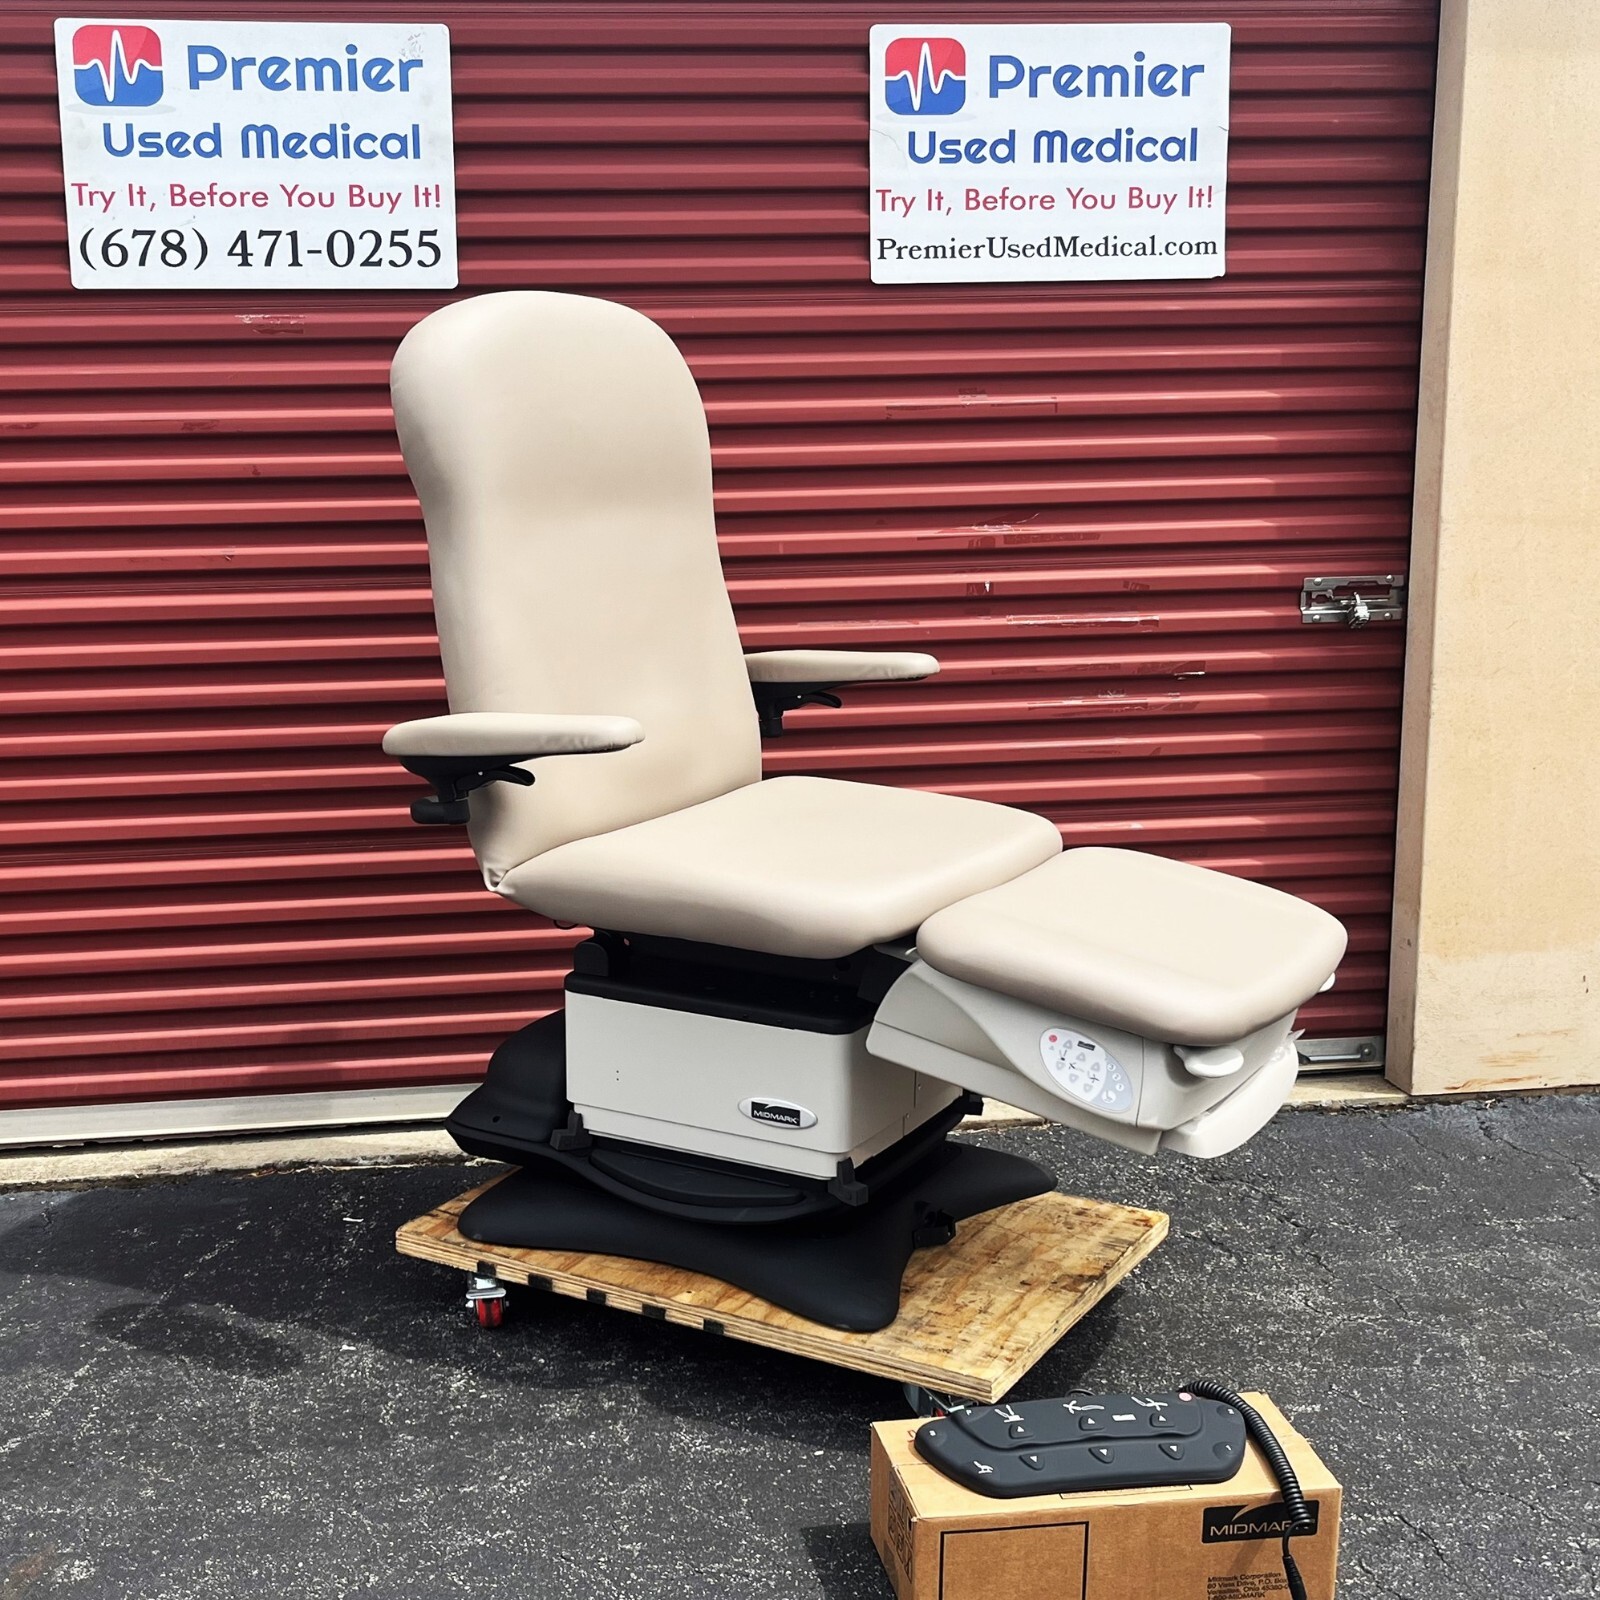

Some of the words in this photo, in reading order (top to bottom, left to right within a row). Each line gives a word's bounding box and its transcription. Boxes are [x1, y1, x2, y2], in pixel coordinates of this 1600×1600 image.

[188, 44, 424, 93] Premier
[989, 51, 1205, 98] Premier
[103, 123, 222, 158] Used
[241, 123, 421, 159] Medical
[908, 129, 1015, 164] Used
[1034, 127, 1197, 163] Medical
[71, 183, 115, 212] Try
[129, 184, 156, 211] It,
[170, 183, 268, 208] Before
[280, 185, 335, 208] You
[349, 185, 402, 213] Buy
[414, 185, 441, 208] It!
[876, 189, 916, 217] Try
[927, 189, 952, 215] It,
[966, 187, 1055, 211] Before
[1067, 187, 1116, 210] You
[1129, 186, 1177, 214] Buy
[1188, 186, 1213, 208] It!
[80, 228, 208, 270] (678)
[227, 229, 441, 268] 471-0255
[877, 235, 1218, 260] PremierUsedMedical.com
[753, 1110, 798, 1124] MIDMARK
[1240, 1572, 1281, 1580] Corporation
